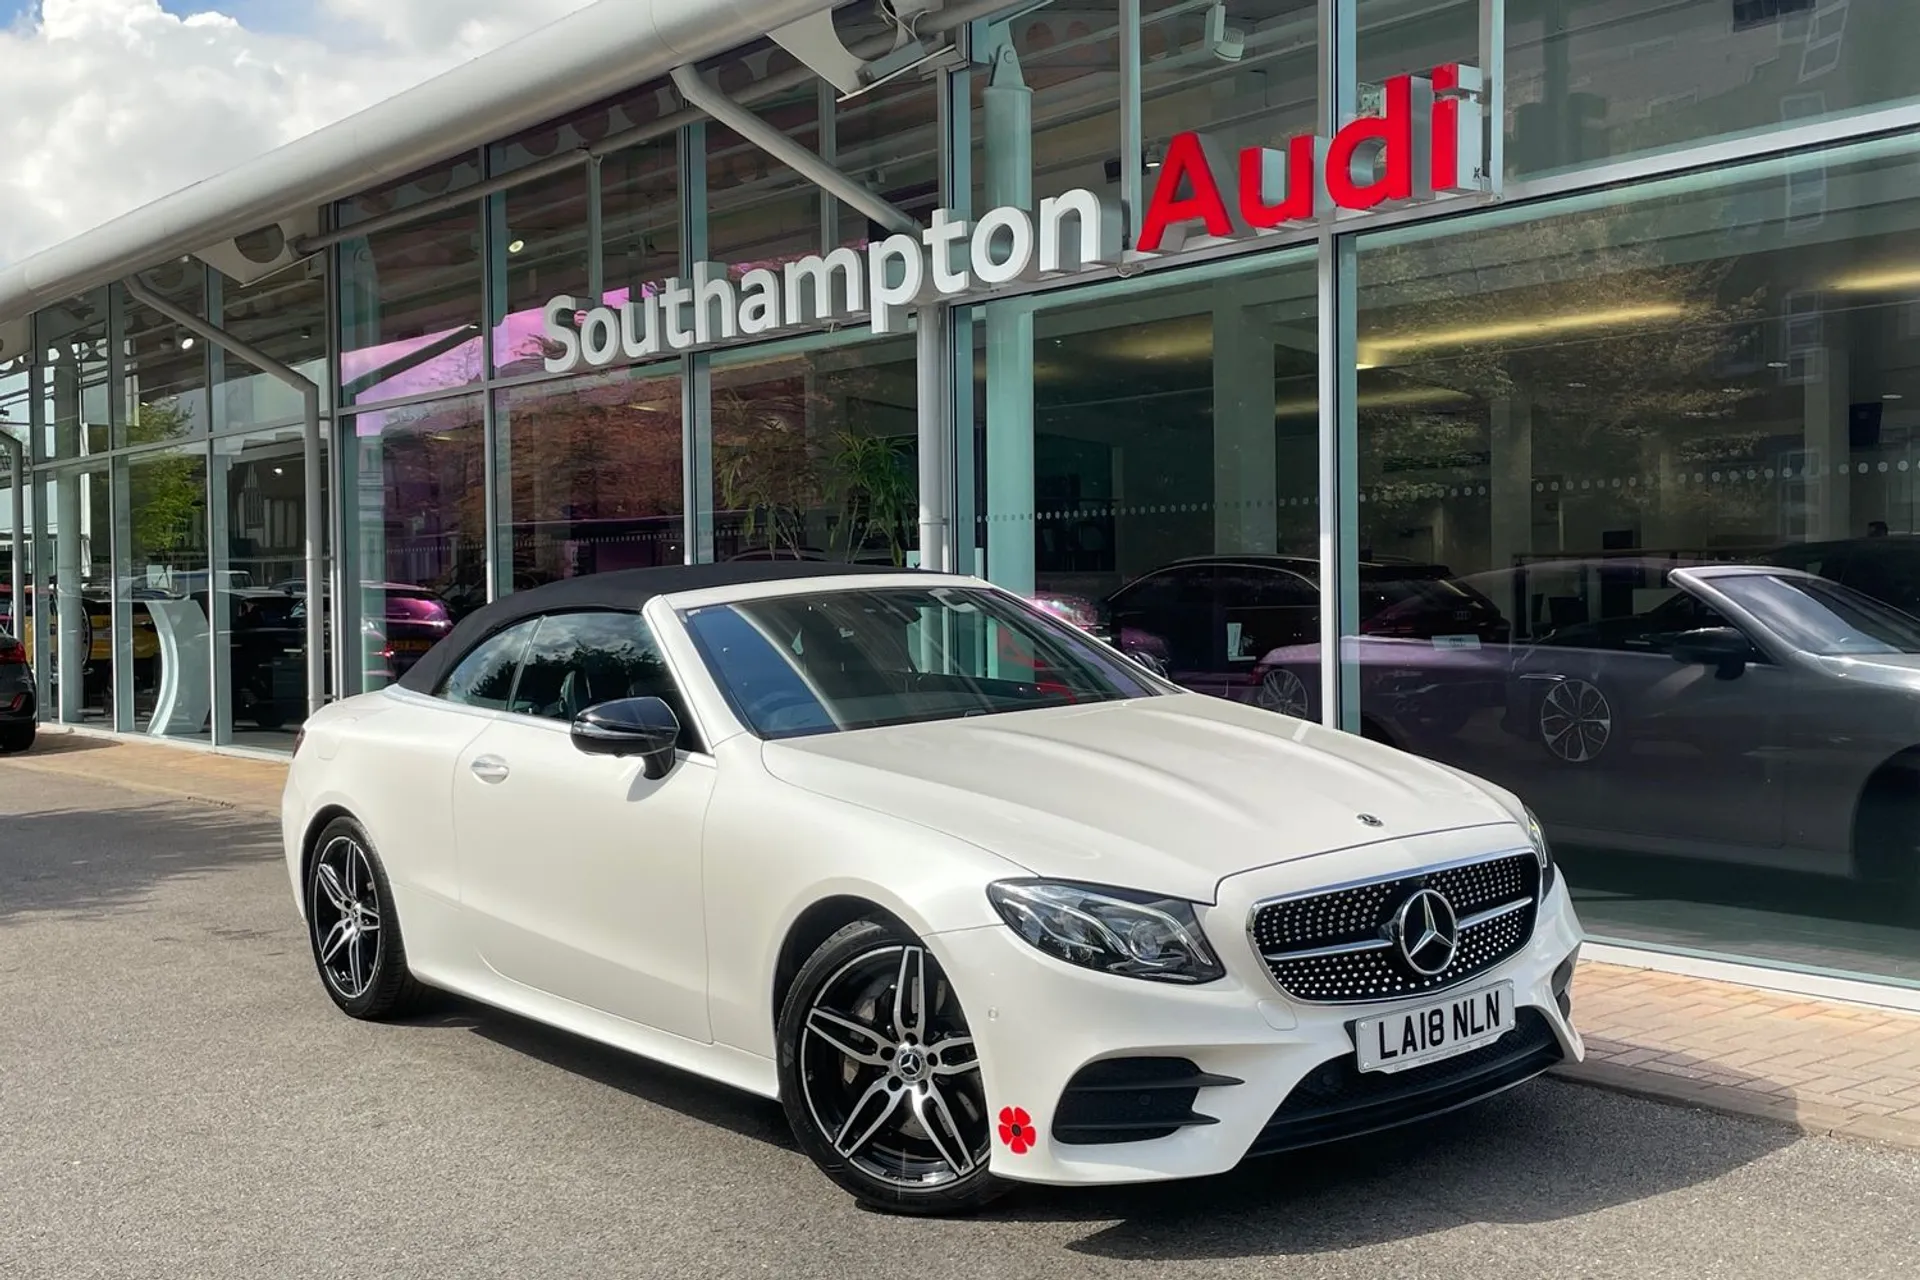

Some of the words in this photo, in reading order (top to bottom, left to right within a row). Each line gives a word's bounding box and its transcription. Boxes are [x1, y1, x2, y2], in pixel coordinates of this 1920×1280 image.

[544, 187, 1103, 373] Southampton
[1136, 63, 1464, 252] Audi
[1378, 1008, 1445, 1060] LA18
[1453, 990, 1500, 1040] NLN
